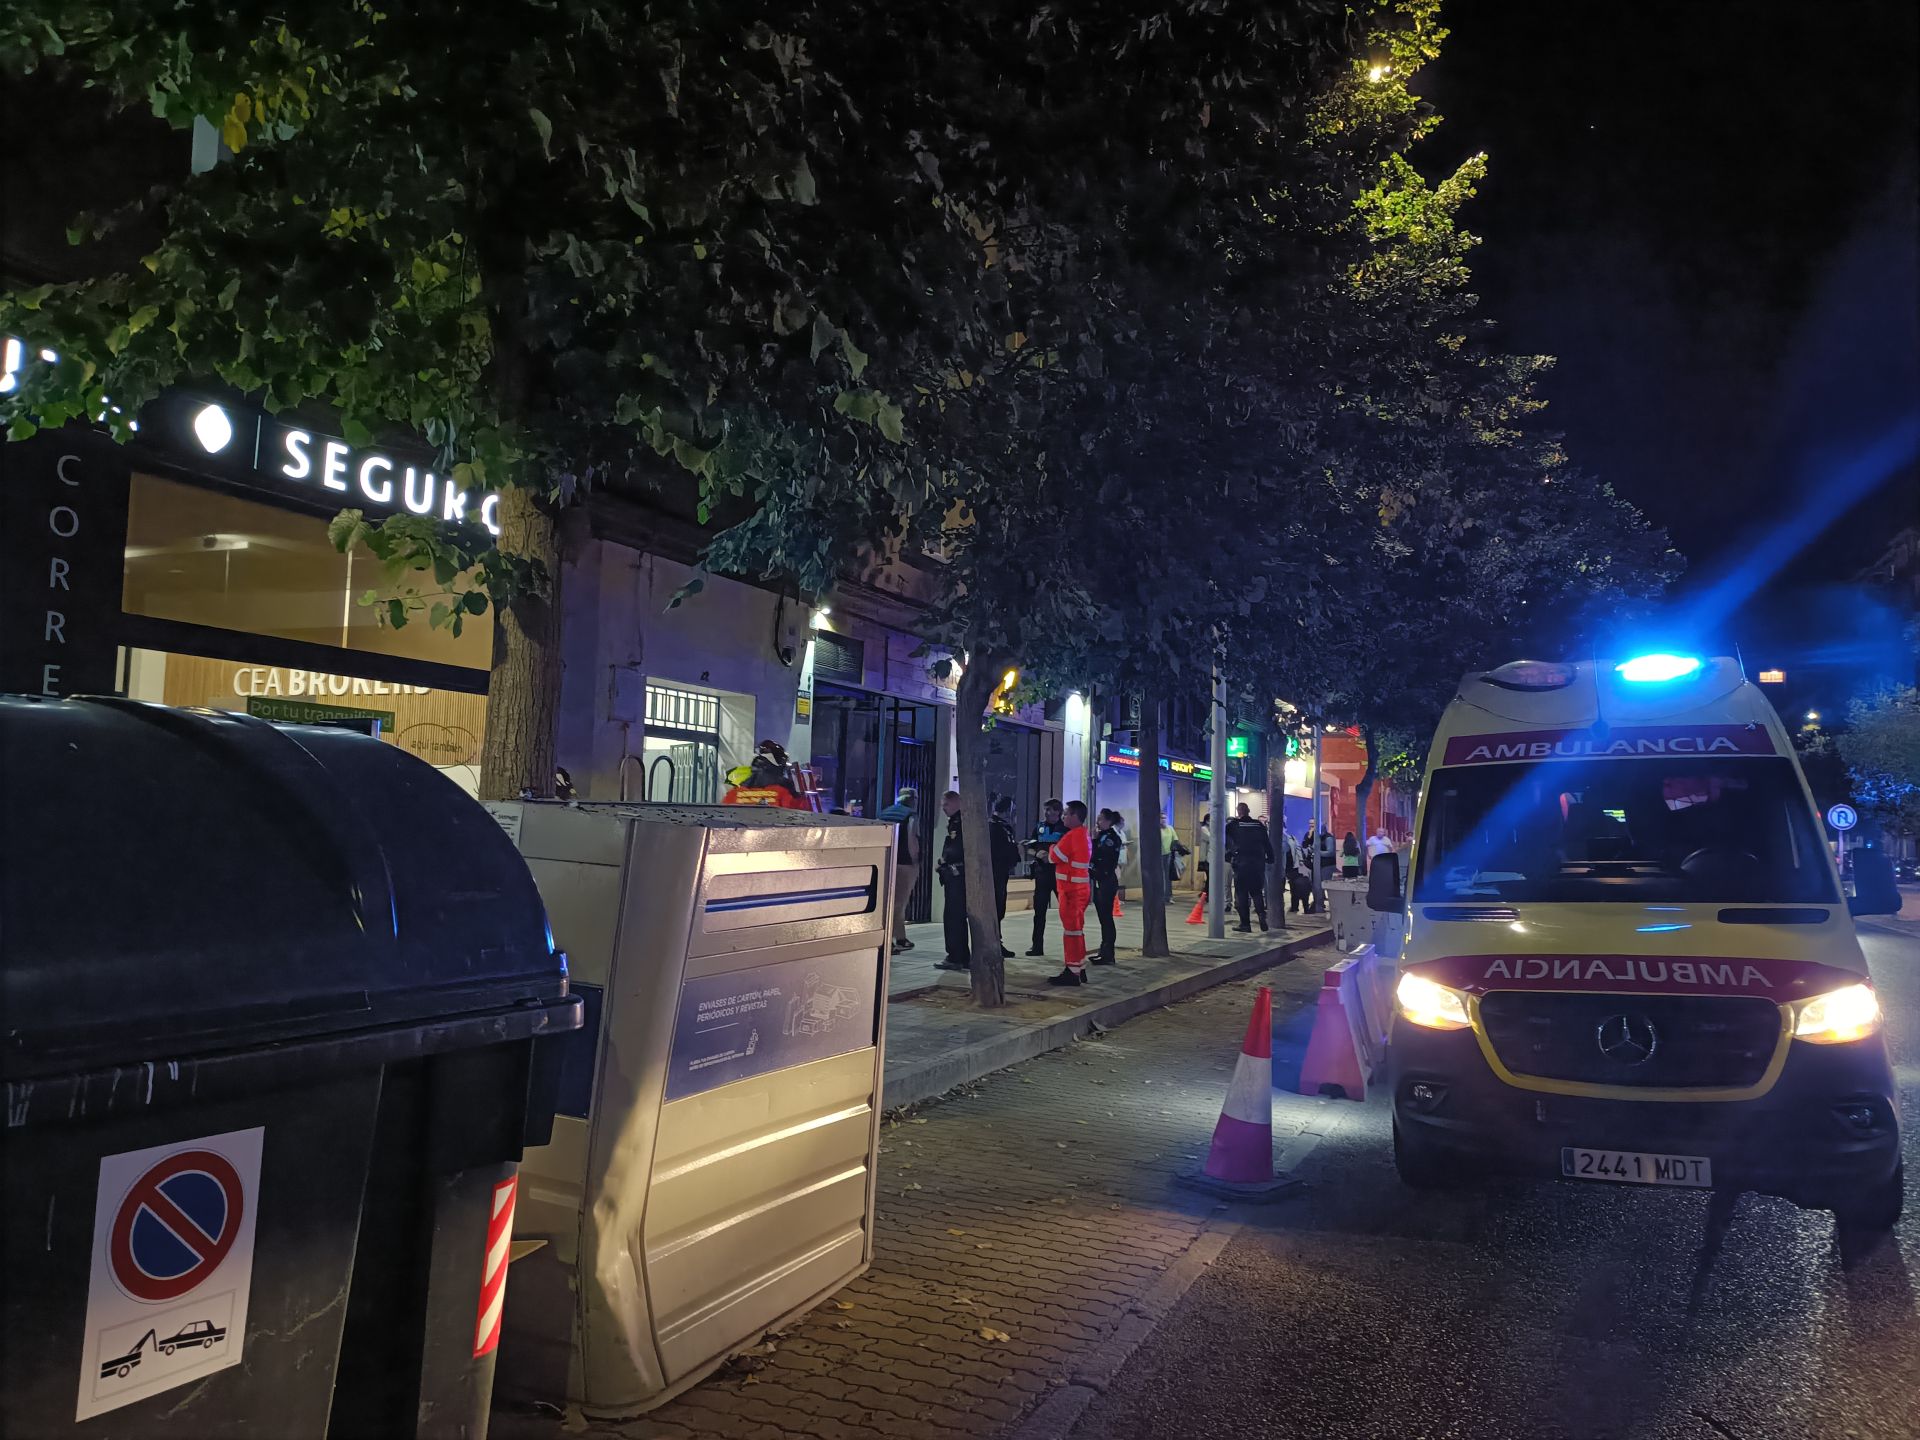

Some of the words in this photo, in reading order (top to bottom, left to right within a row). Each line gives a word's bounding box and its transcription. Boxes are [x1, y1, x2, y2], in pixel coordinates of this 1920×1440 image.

[233, 667, 283, 697] CEA
[287, 668, 431, 696] BROK
[250, 701, 278, 717] Por
[283, 704, 299, 719] tu
[1465, 736, 1741, 761] AMBULANCIA
[697, 1007, 735, 1022] PERIÓDICOS
[735, 1006, 741, 1014] Y
[740, 1000, 768, 1013] REVISTAS
[698, 998, 728, 1012] ENVASES
[727, 996, 738, 1005] DE
[1580, 1152, 1643, 1179] 2441
[1654, 1157, 1704, 1182] MDT
